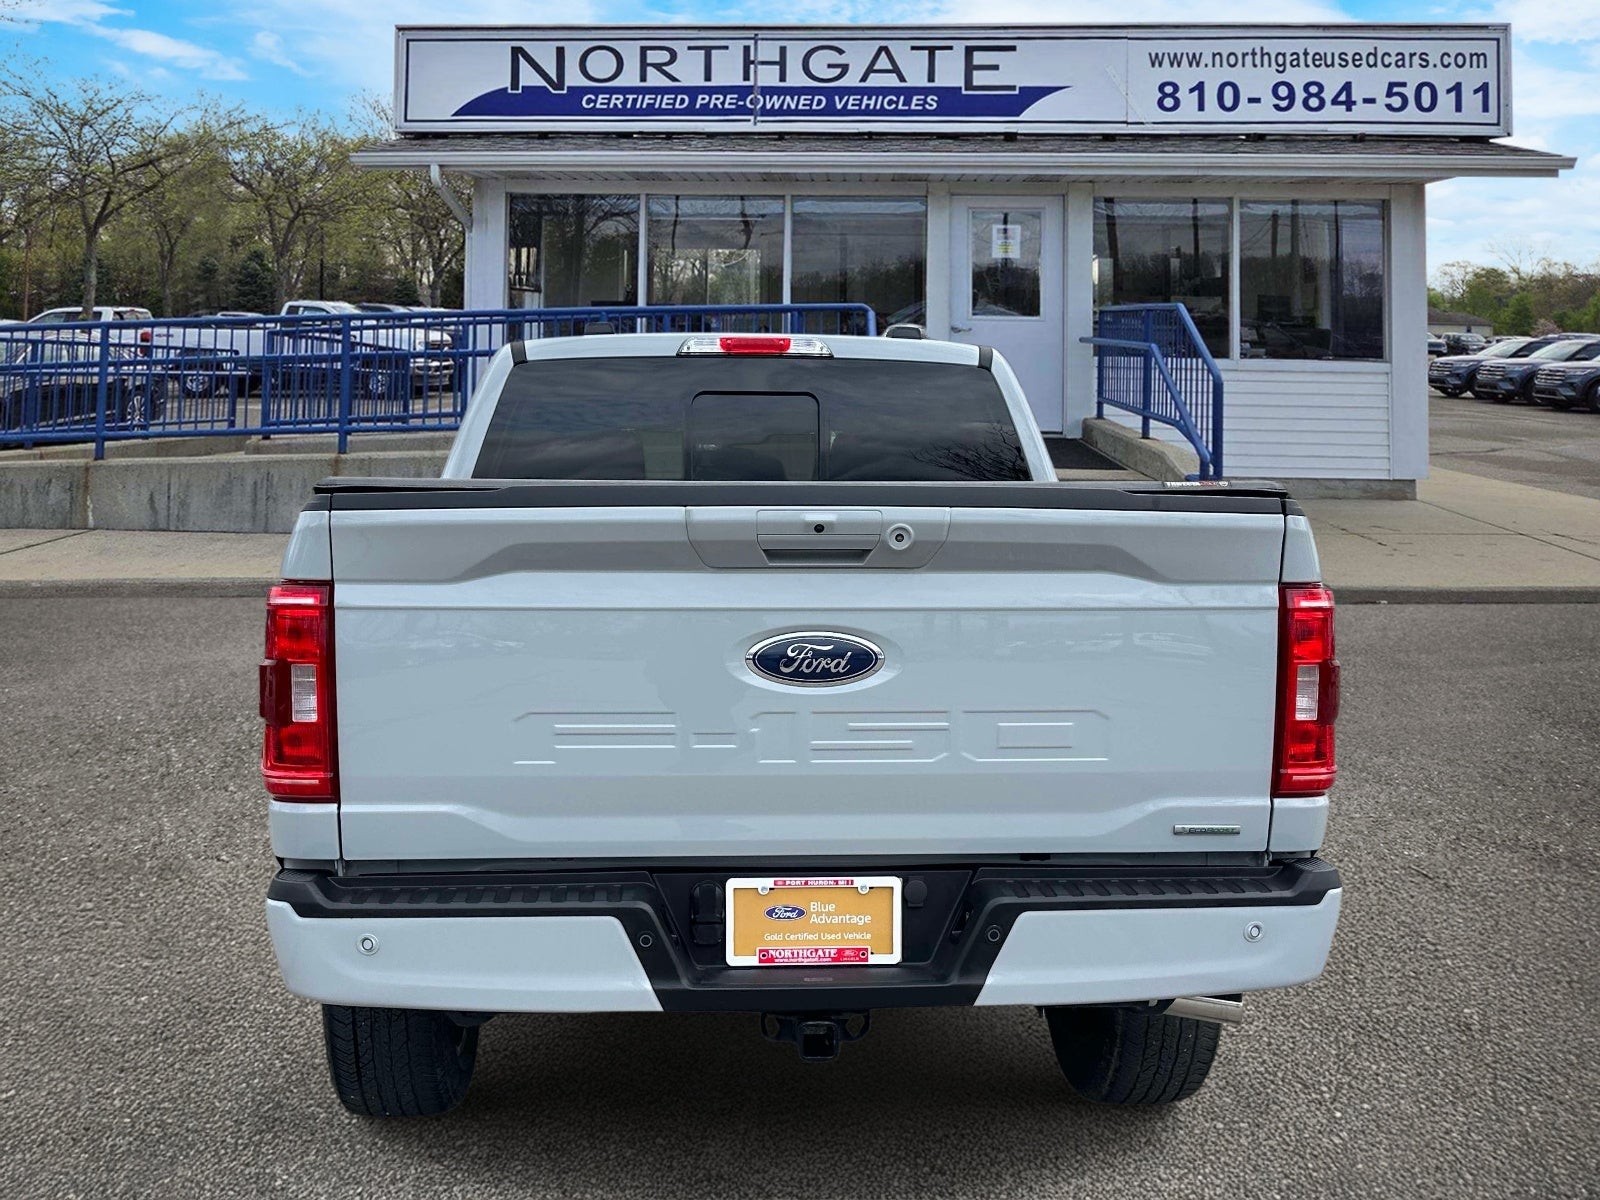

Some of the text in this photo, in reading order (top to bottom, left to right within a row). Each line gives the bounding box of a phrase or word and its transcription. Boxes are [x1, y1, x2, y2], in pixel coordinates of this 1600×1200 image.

[1148, 46, 1489, 73] www.northgateusedcars.com
[510, 44, 1018, 92] NORTHGATE
[581, 93, 939, 111] CERTIFIED PRE-OWNED VEHICLES
[1156, 80, 1491, 113] 810-984-5011
[780, 643, 852, 673] Ford
[772, 906, 799, 919] Ford
[810, 901, 836, 912] Blue
[810, 913, 872, 926] Advantage
[764, 932, 872, 941] Gold Certified Used Vehicle
[768, 948, 838, 958] NORTHGATE
